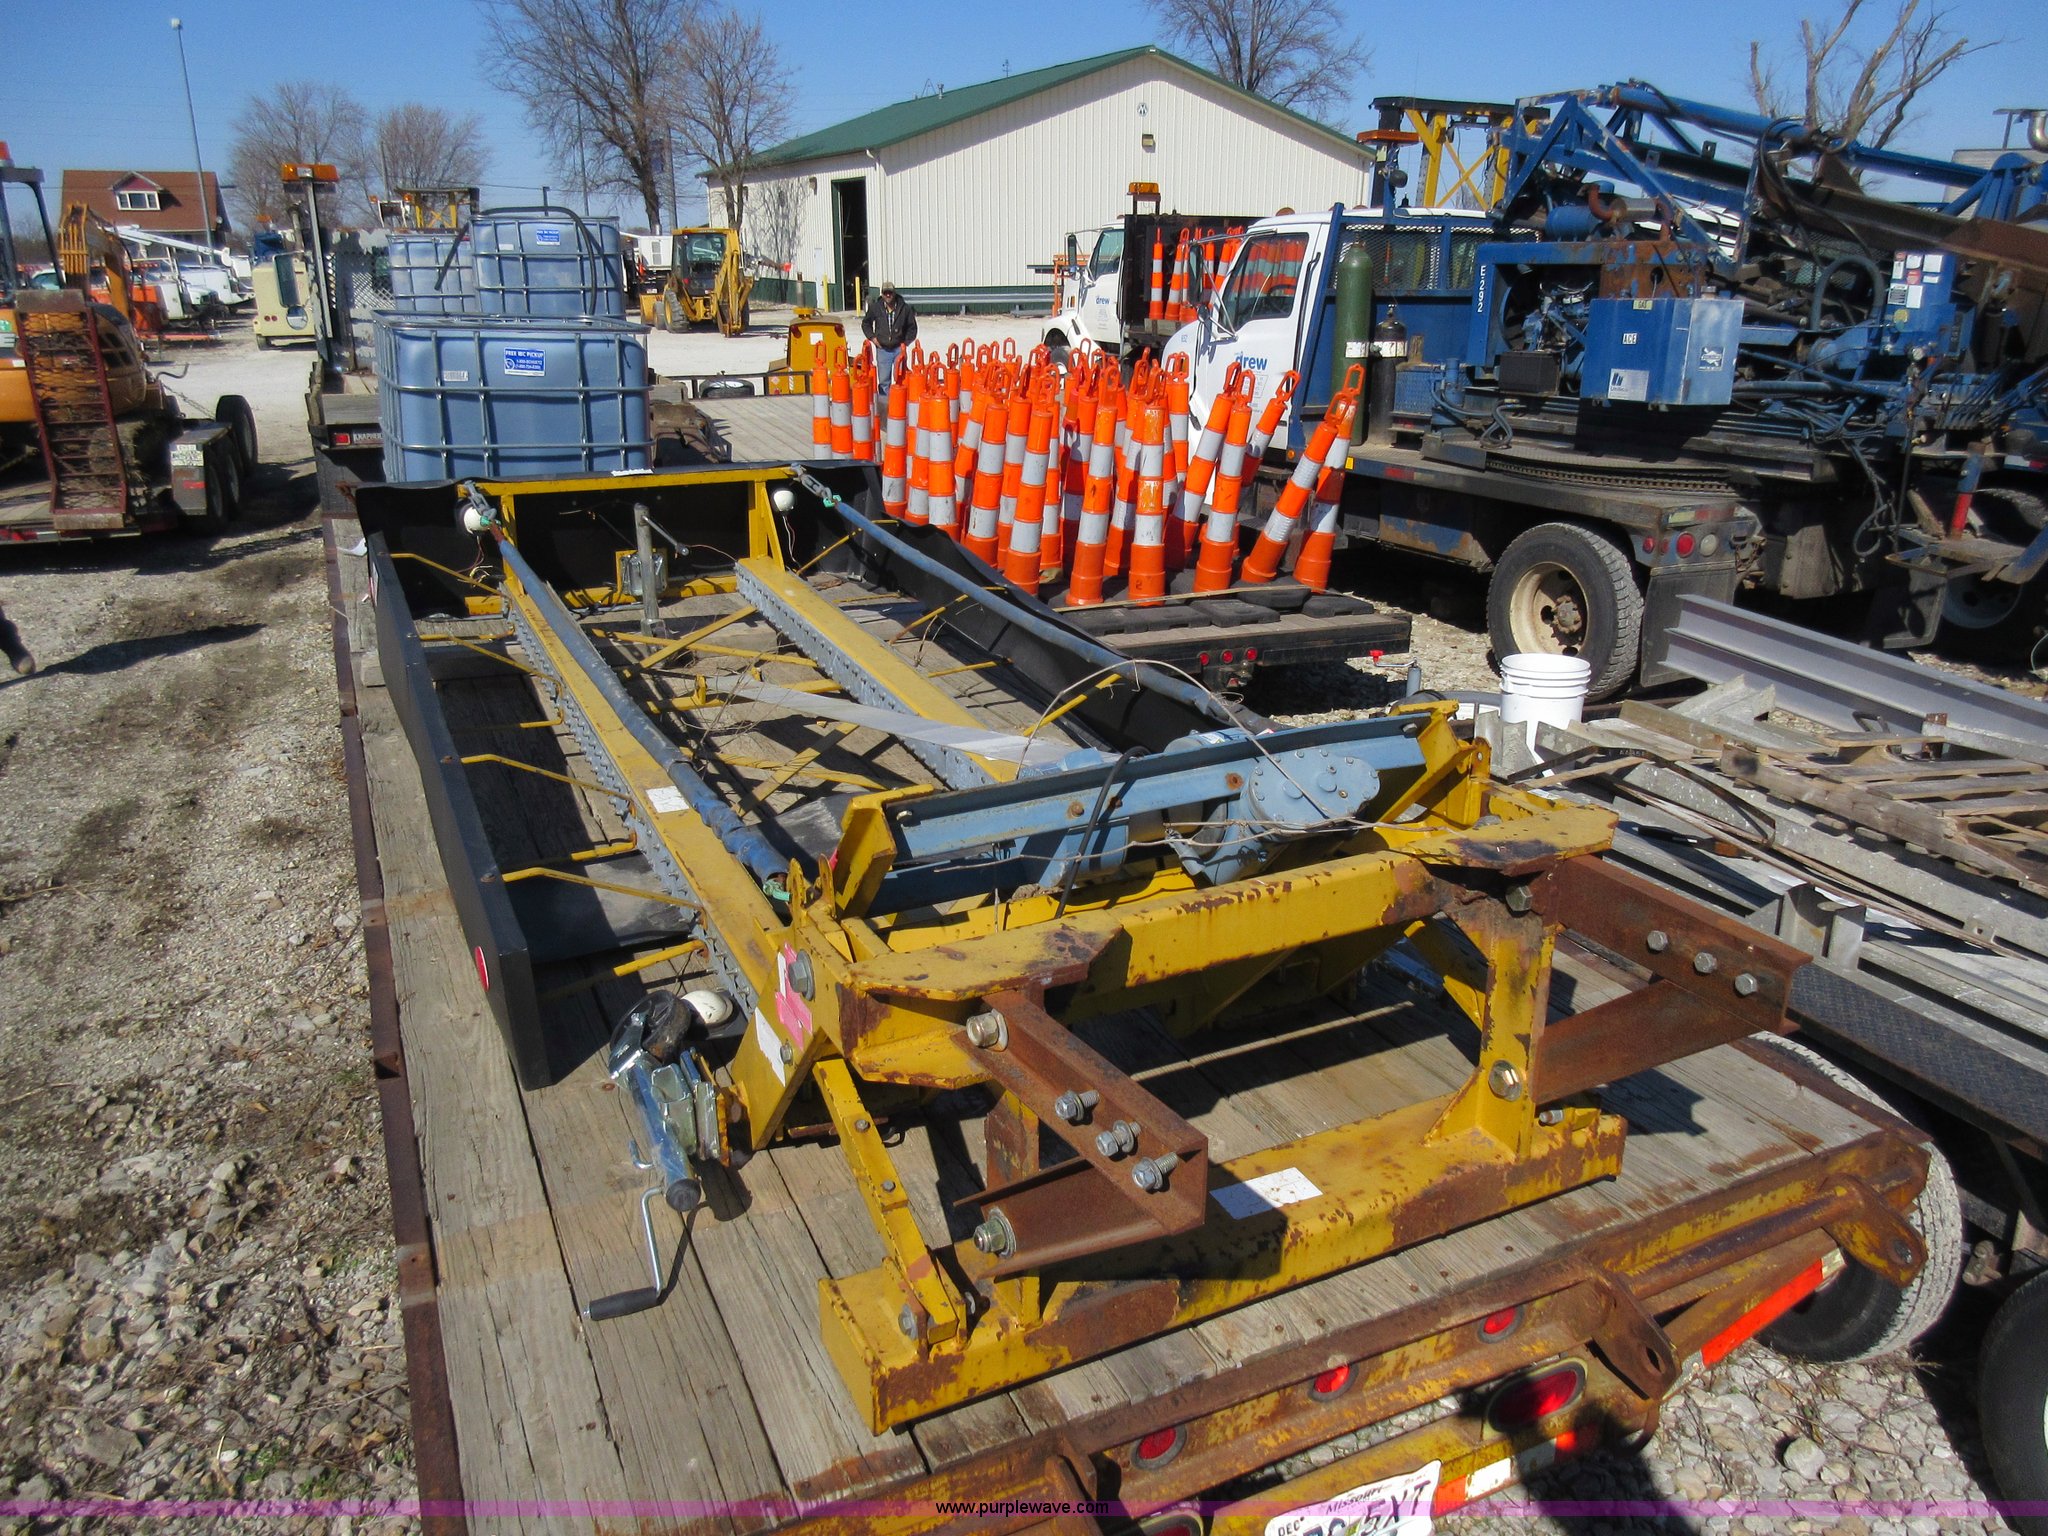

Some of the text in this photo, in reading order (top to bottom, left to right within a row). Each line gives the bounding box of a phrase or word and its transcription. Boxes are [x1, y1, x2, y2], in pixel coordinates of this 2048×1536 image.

[1095, 296, 1110, 305] drew
[1623, 333, 1637, 344] ACE
[1235, 351, 1268, 371] drew
[1325, 1486, 1384, 1514] Missouri
[1278, 1519, 1300, 1536] DEC
